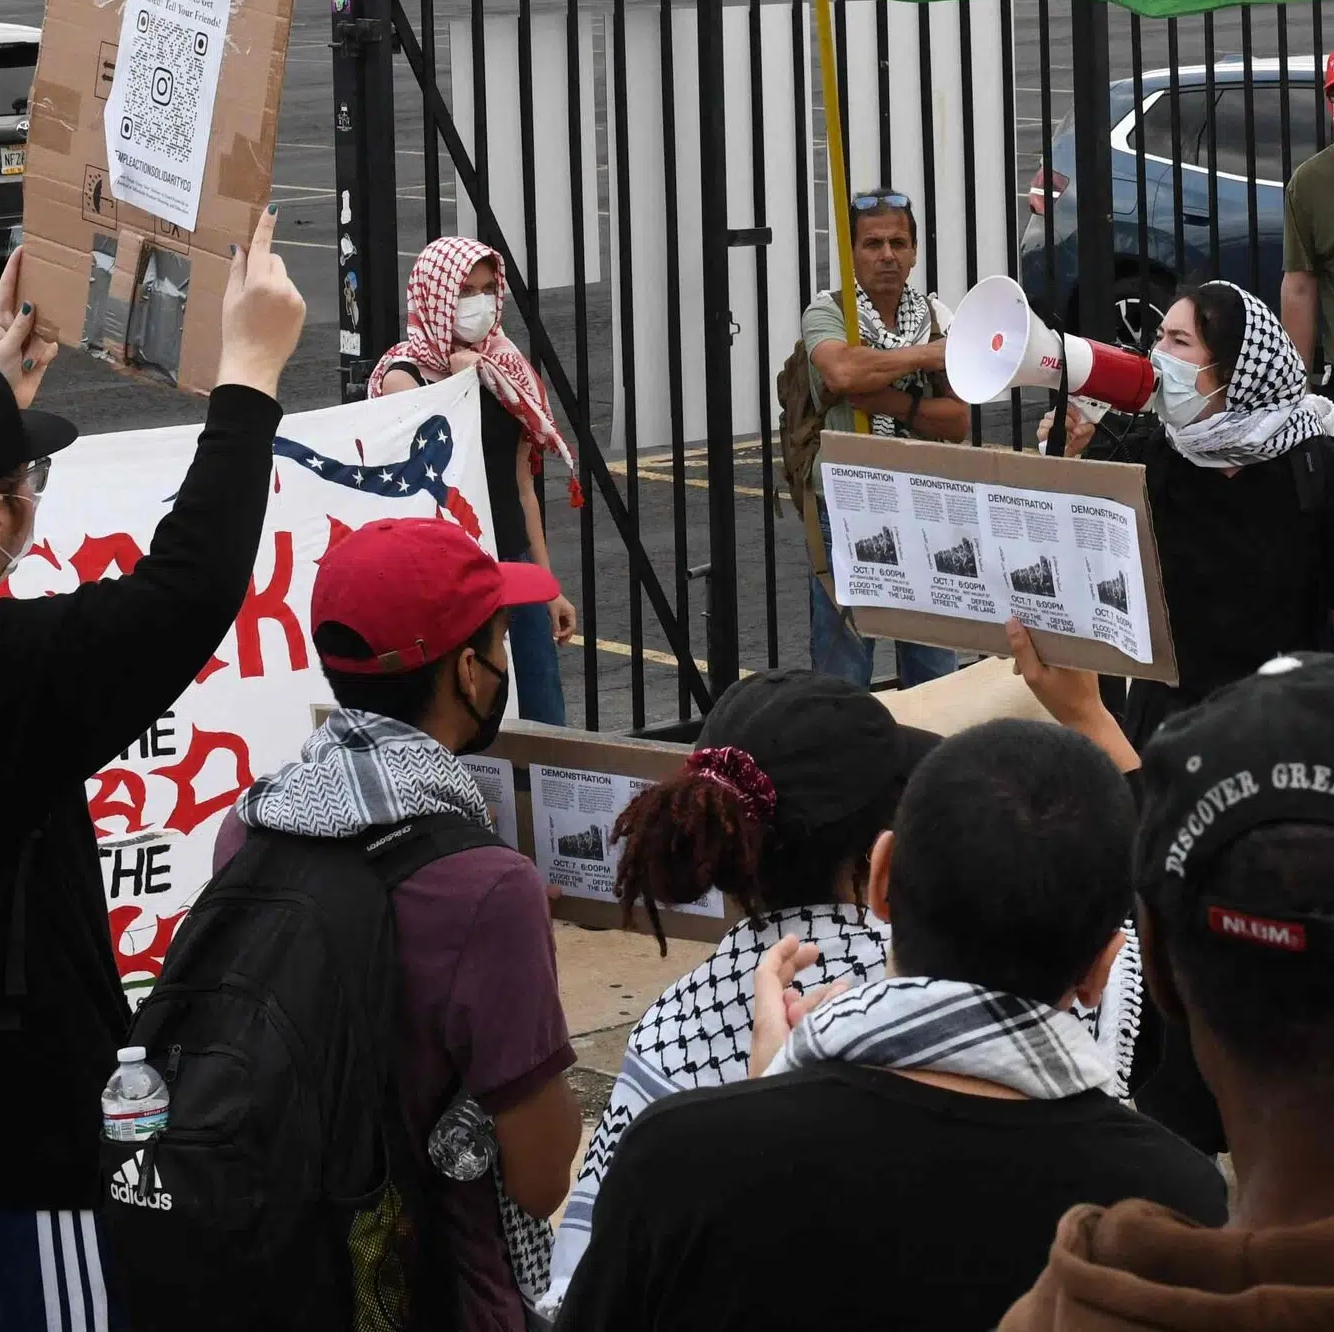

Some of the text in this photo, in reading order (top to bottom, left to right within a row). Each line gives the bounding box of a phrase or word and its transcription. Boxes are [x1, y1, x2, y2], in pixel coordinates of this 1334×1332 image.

[178, 3, 193, 18] Your
[194, 10, 222, 29] Friends!
[114, 149, 192, 193] MPLEACTIONSOLIDARITYCO
[831, 467, 894, 483] DEMONSTRATION
[909, 477, 974, 494] DEMONSTRATION
[987, 493, 1053, 511] DEMONSTRATION
[1070, 504, 1128, 526] DEMONSTRATION
[879, 567, 906, 579] 6:00PM
[849, 581, 883, 590] FLOOD THE
[957, 579, 986, 591] 6:00PM
[930, 591, 951, 600] FLOOD
[951, 594, 963, 603] THE
[120, 709, 177, 762] HE
[541, 767, 612, 786] DEMONSTRATION
[1165, 769, 1260, 878] DISCOVER
[592, 878, 615, 888] DEFEN
[599, 885, 615, 894] LAN
[109, 1180, 173, 1212] adidas
